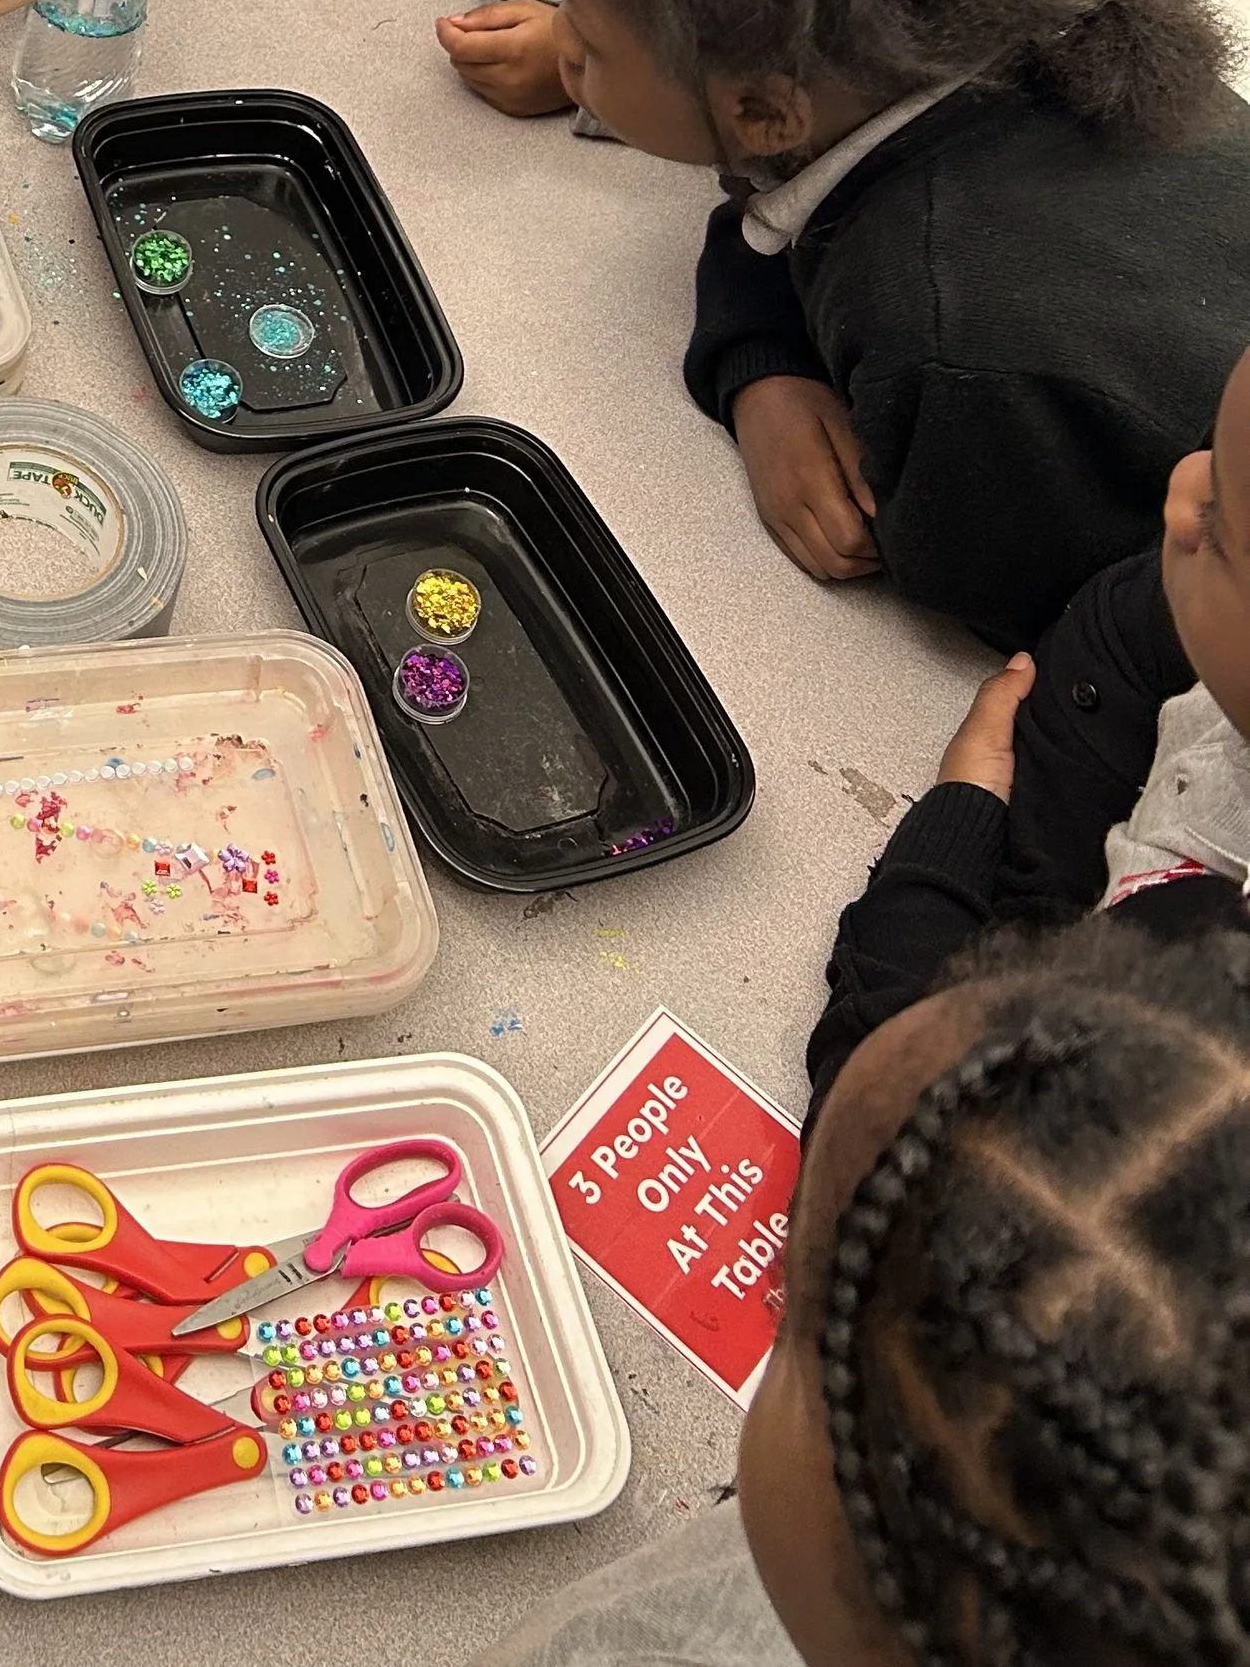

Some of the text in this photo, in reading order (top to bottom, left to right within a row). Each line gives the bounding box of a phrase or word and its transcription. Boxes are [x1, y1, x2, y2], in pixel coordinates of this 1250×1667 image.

[12, 470, 51, 485] TAPE
[74, 489, 104, 525] DUCK
[568, 1076, 688, 1205] 3 People
[637, 1134, 712, 1213] Only
[666, 1158, 763, 1276] At This
[710, 1212, 790, 1300] Table
